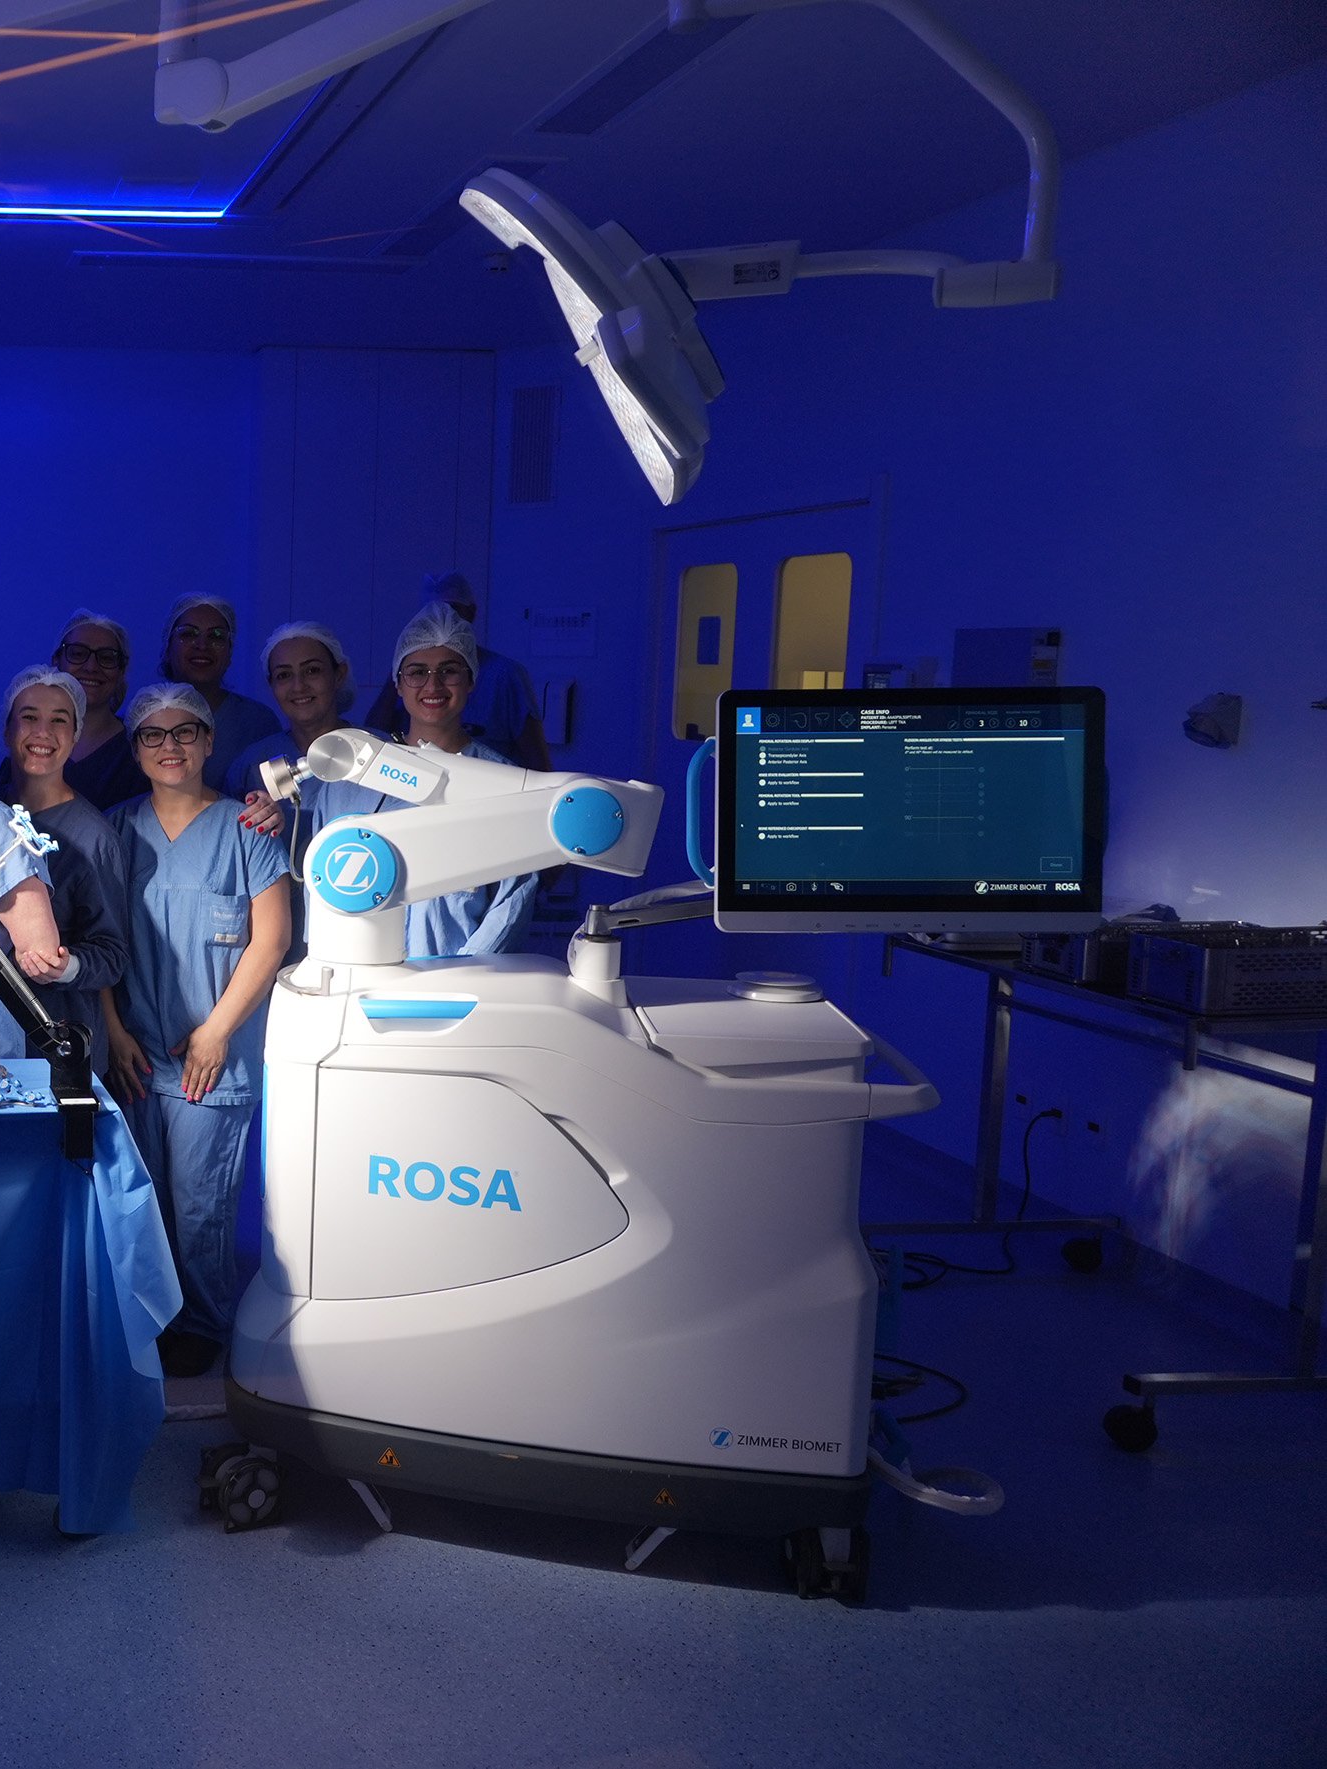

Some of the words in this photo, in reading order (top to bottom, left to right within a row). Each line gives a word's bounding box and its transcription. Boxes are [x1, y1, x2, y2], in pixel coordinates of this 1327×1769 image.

[979, 719, 985, 727] 3
[1019, 719, 1028, 727] 10
[379, 764, 418, 787] ROSA
[990, 883, 1018, 891] ZIMMER
[1019, 883, 1047, 891] BIOMET
[1055, 882, 1081, 891] ROSA
[368, 1155, 522, 1212] ROSA
[737, 1434, 788, 1449] ZIMMER
[791, 1439, 842, 1453] BIOMET
